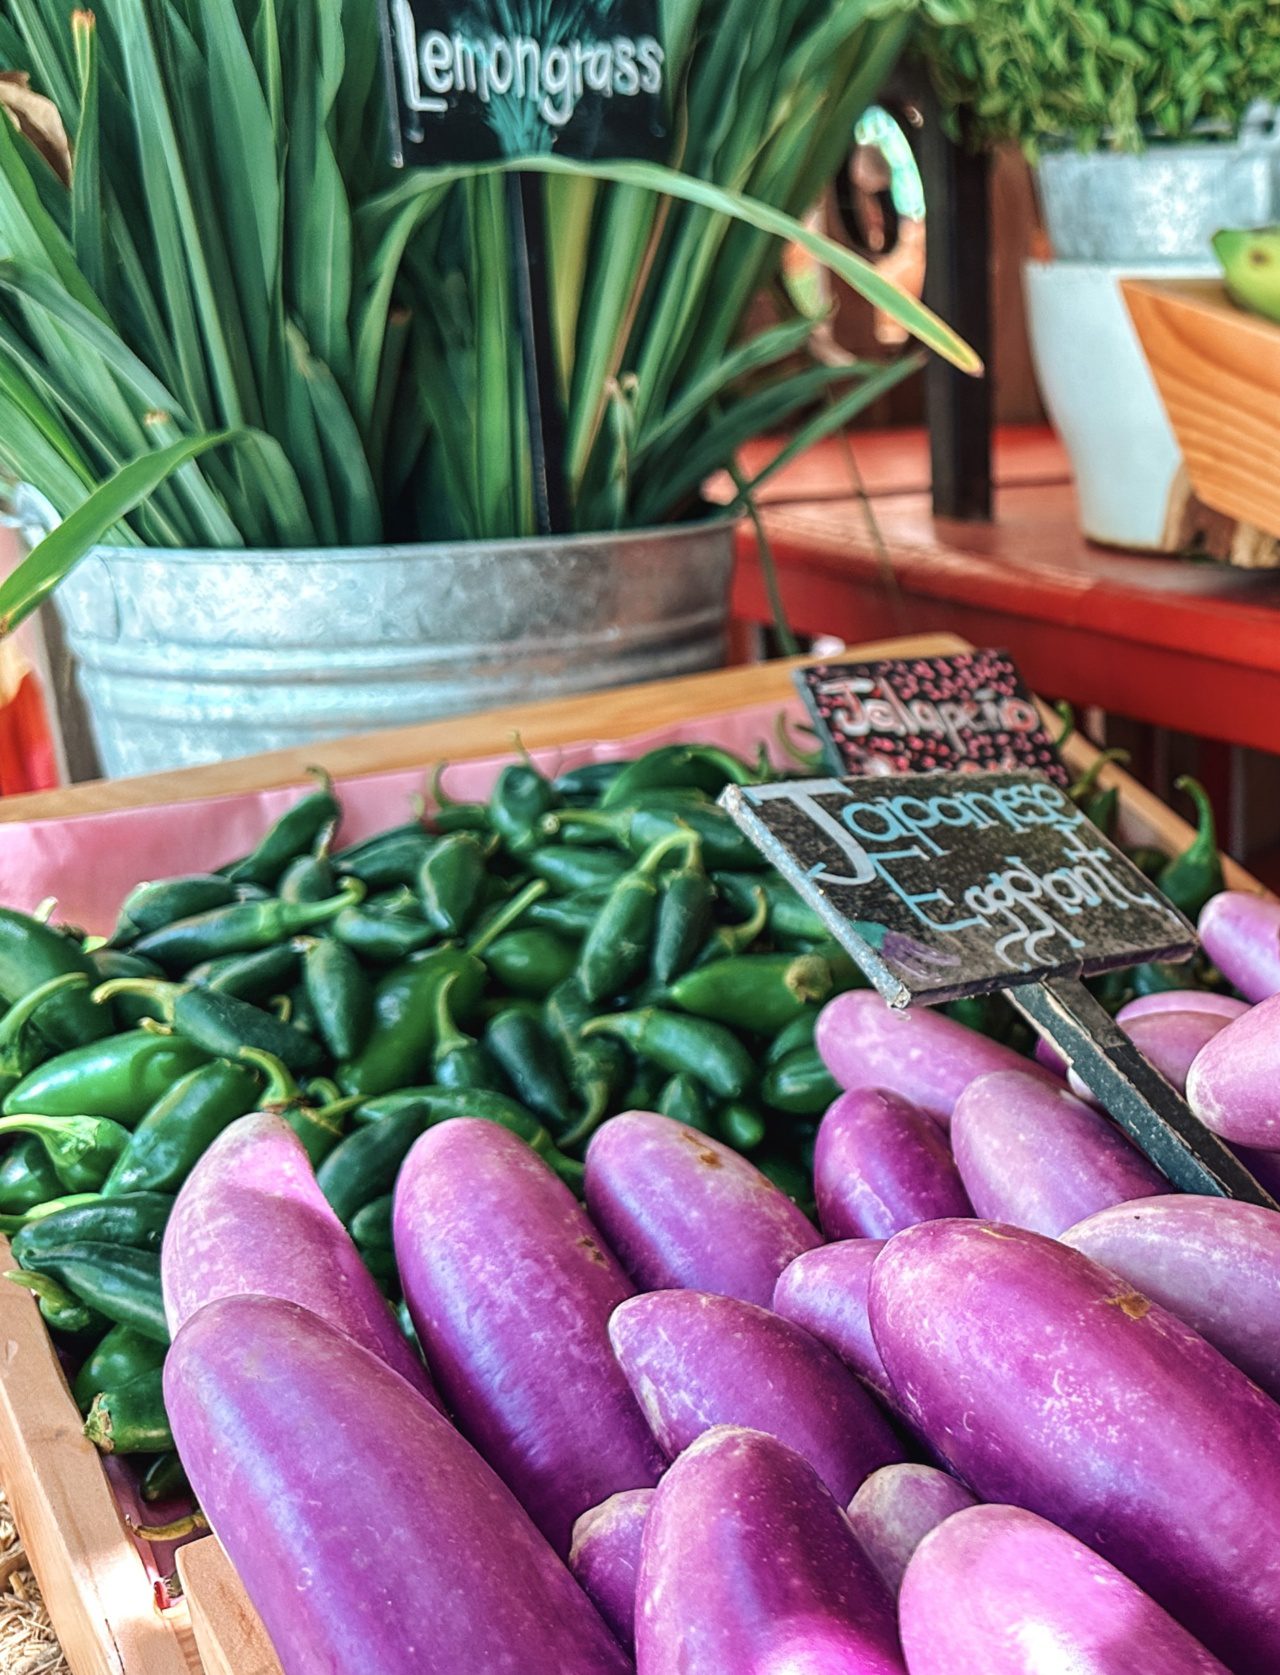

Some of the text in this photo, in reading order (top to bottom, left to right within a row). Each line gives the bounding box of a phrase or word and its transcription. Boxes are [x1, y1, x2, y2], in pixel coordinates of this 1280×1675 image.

[393, 0, 664, 125] Lemongrass
[741, 779, 1081, 885] Japanese
[872, 825, 1160, 971] Eggplant
